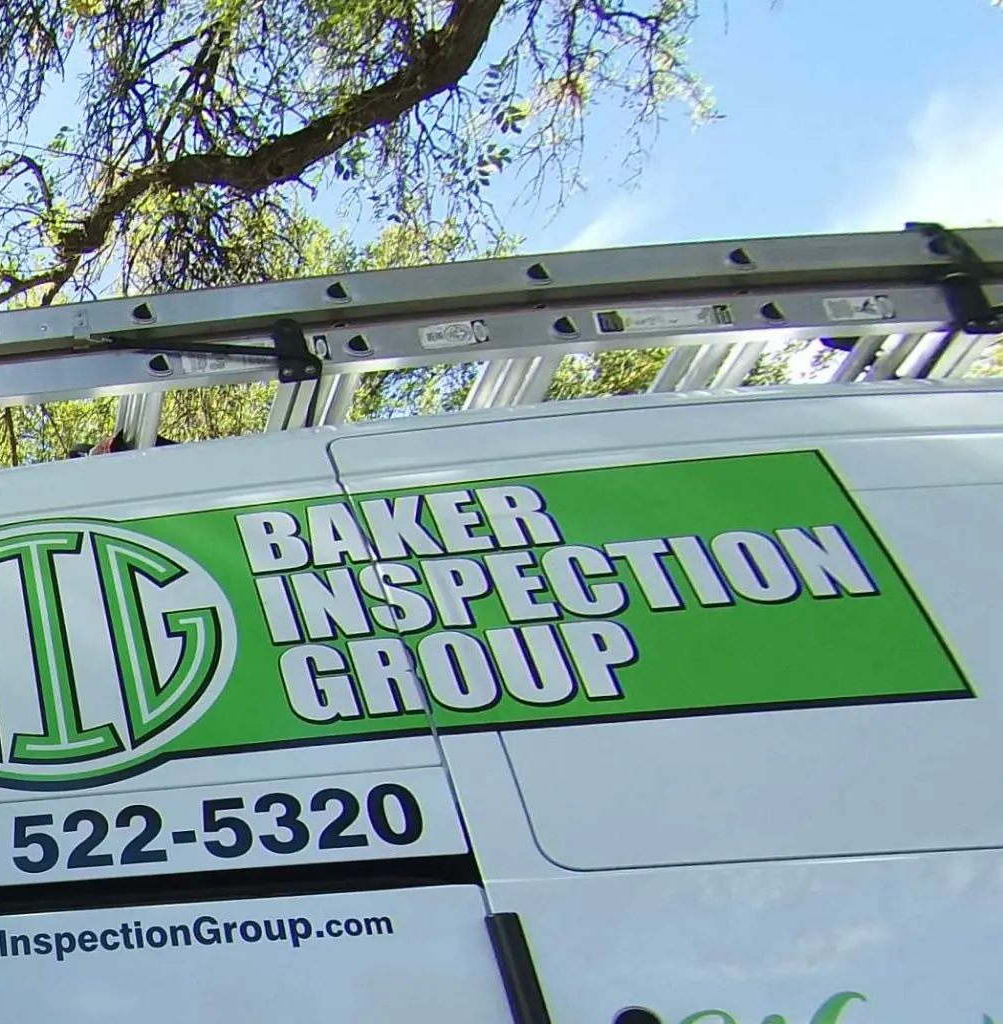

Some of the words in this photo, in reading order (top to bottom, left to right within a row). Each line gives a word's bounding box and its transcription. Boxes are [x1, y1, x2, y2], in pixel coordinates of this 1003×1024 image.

[235, 485, 563, 574] BAKER
[254, 524, 880, 645] INSPECTION
[278, 620, 639, 724] GROUP
[11, 783, 424, 874] 522-5320
